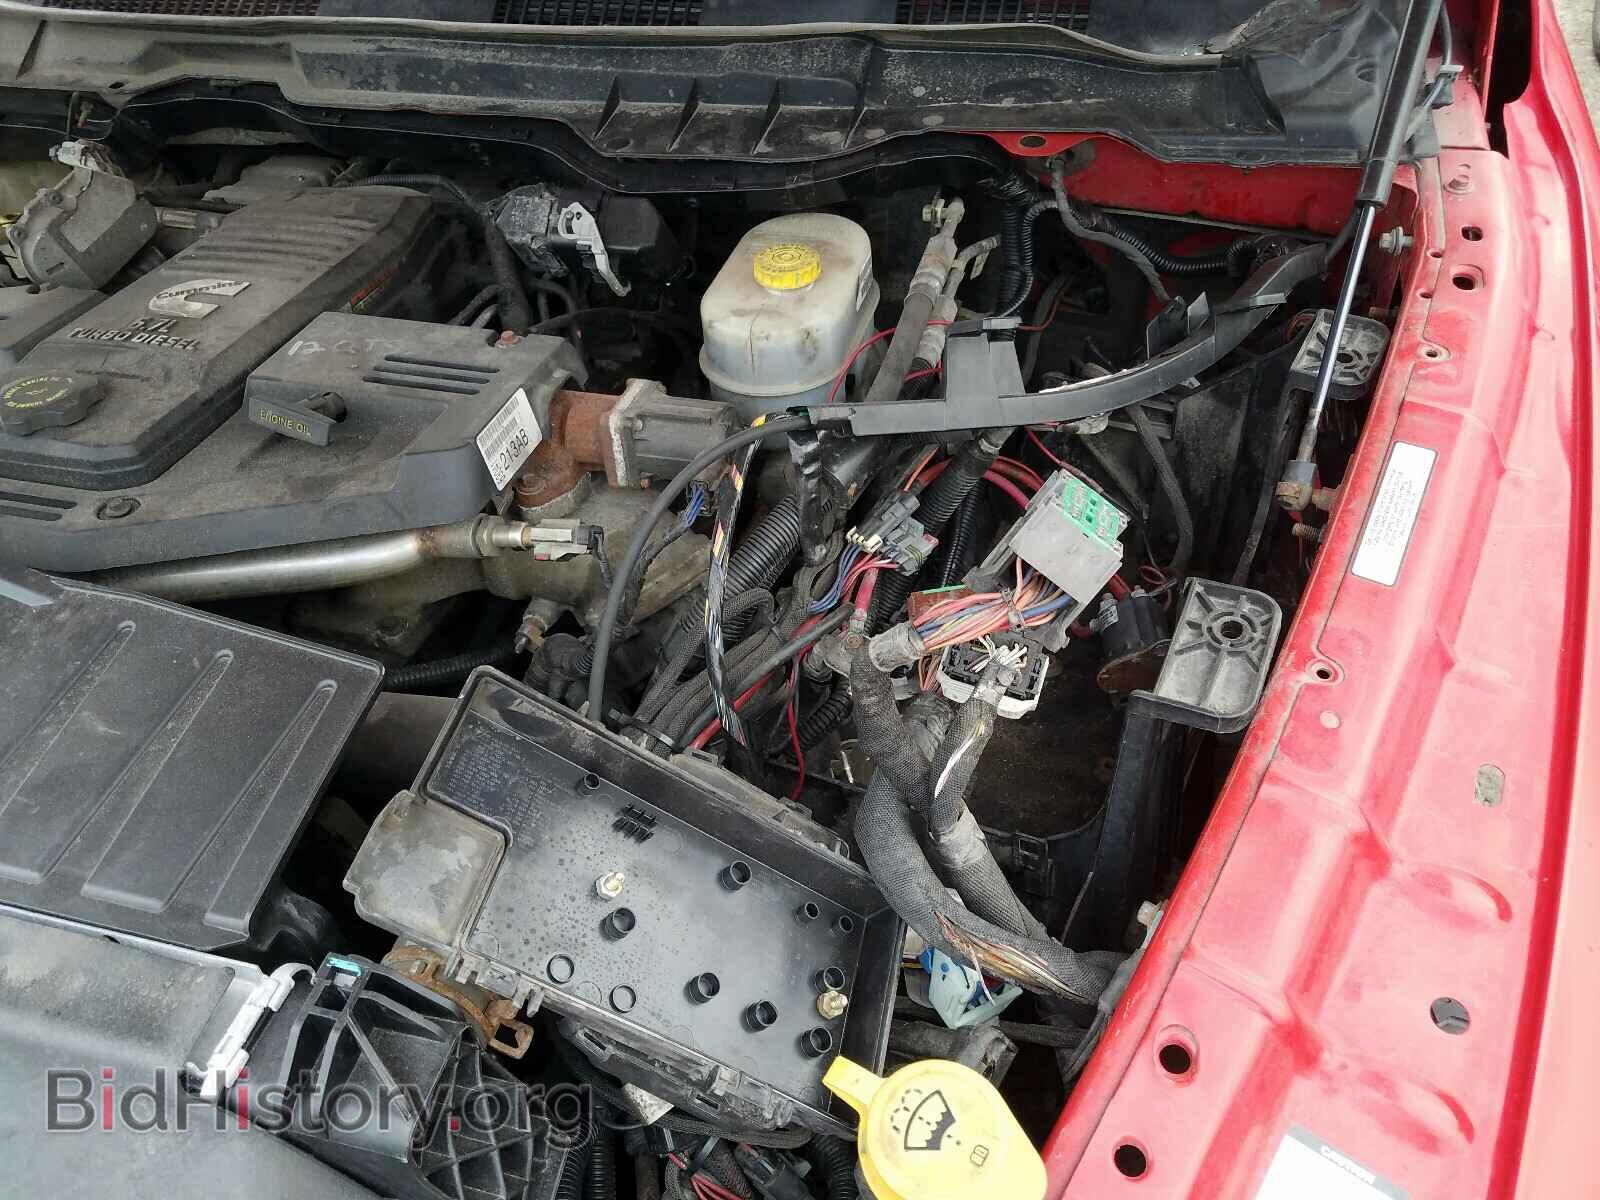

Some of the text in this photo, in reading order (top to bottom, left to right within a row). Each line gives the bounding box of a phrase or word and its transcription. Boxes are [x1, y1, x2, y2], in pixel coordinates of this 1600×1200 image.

[68, 327, 201, 351] TURBO DIESEL
[260, 408, 312, 437] ENGINE OIL
